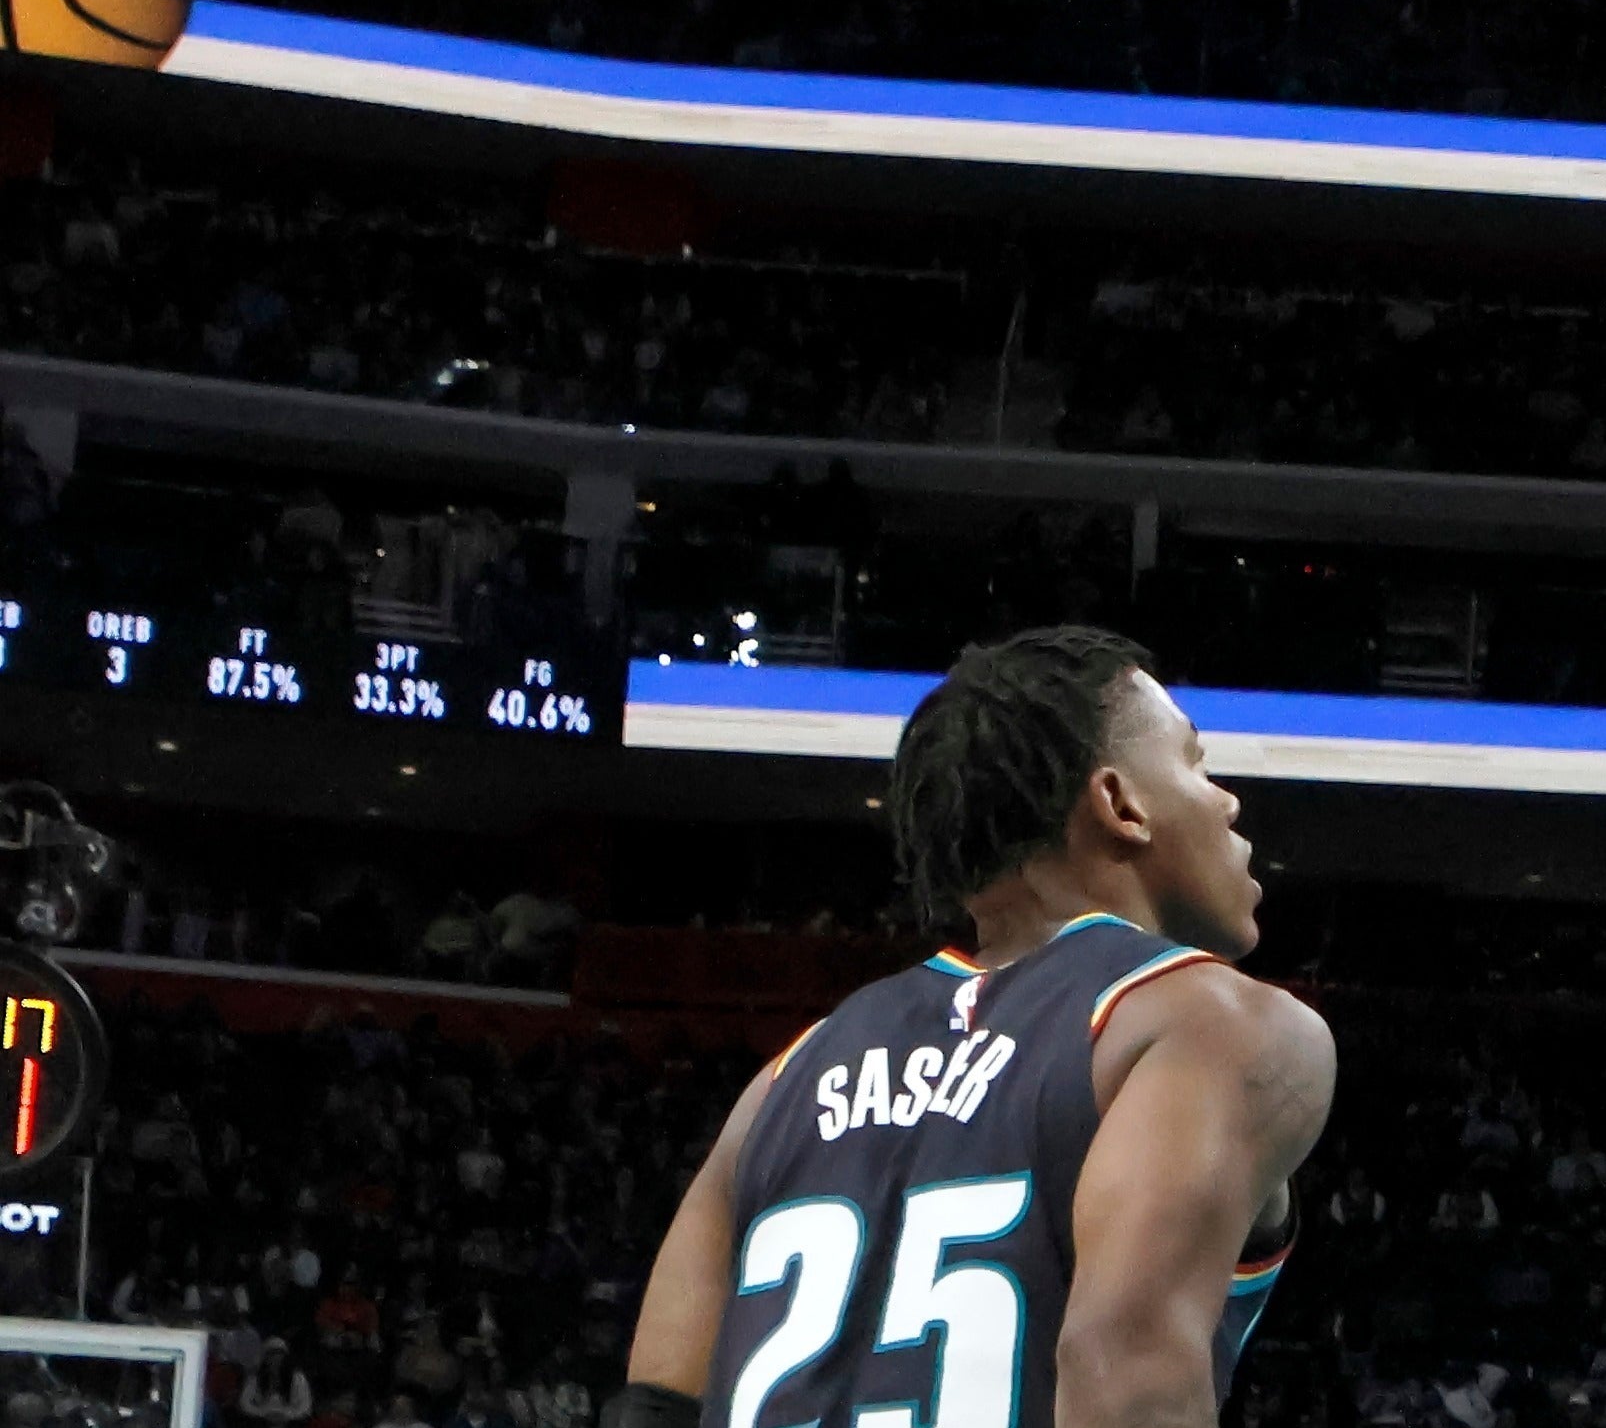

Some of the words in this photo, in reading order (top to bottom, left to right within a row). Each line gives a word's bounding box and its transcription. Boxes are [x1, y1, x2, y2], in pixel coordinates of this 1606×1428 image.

[86, 610, 152, 643] OREB
[239, 627, 268, 657] FT
[105, 645, 127, 684] 3
[375, 643, 419, 672] 3PT
[524, 659, 552, 687] FG
[207, 657, 300, 703] 87.5%
[353, 673, 444, 719] 33.3%
[487, 688, 591, 734] 40.6%
[2, 996, 58, 1054] 17
[816, 1028, 1016, 1142] SASER
